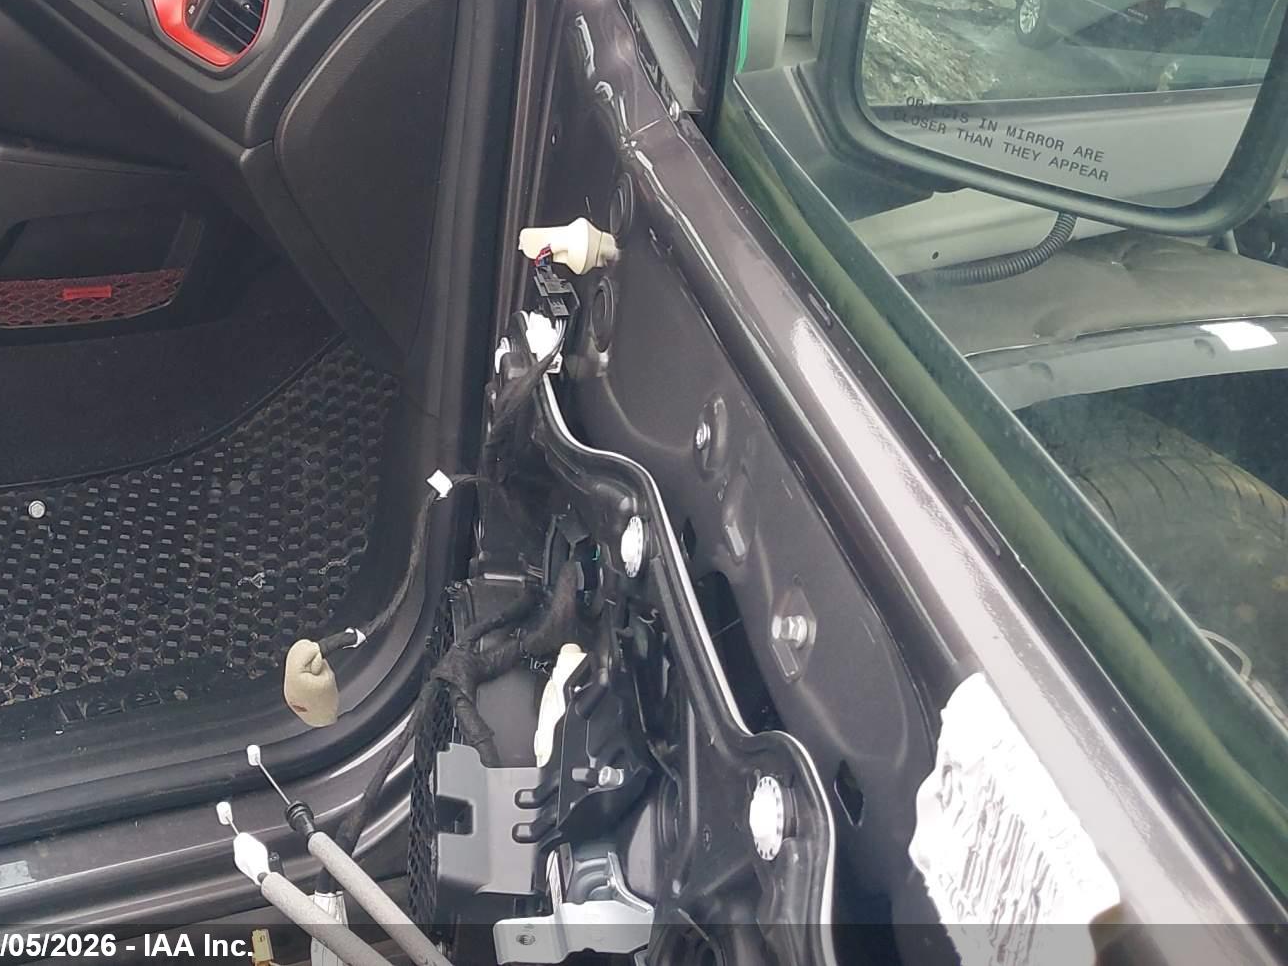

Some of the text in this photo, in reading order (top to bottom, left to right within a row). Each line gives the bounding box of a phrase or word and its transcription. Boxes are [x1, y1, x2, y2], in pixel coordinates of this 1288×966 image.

[893, 109, 1109, 182] CLOSER THAN THEY APPEAR
[979, 118, 998, 132] IN
[1006, 126, 1065, 152] MIRROR
[1073, 146, 1105, 163] ARE
